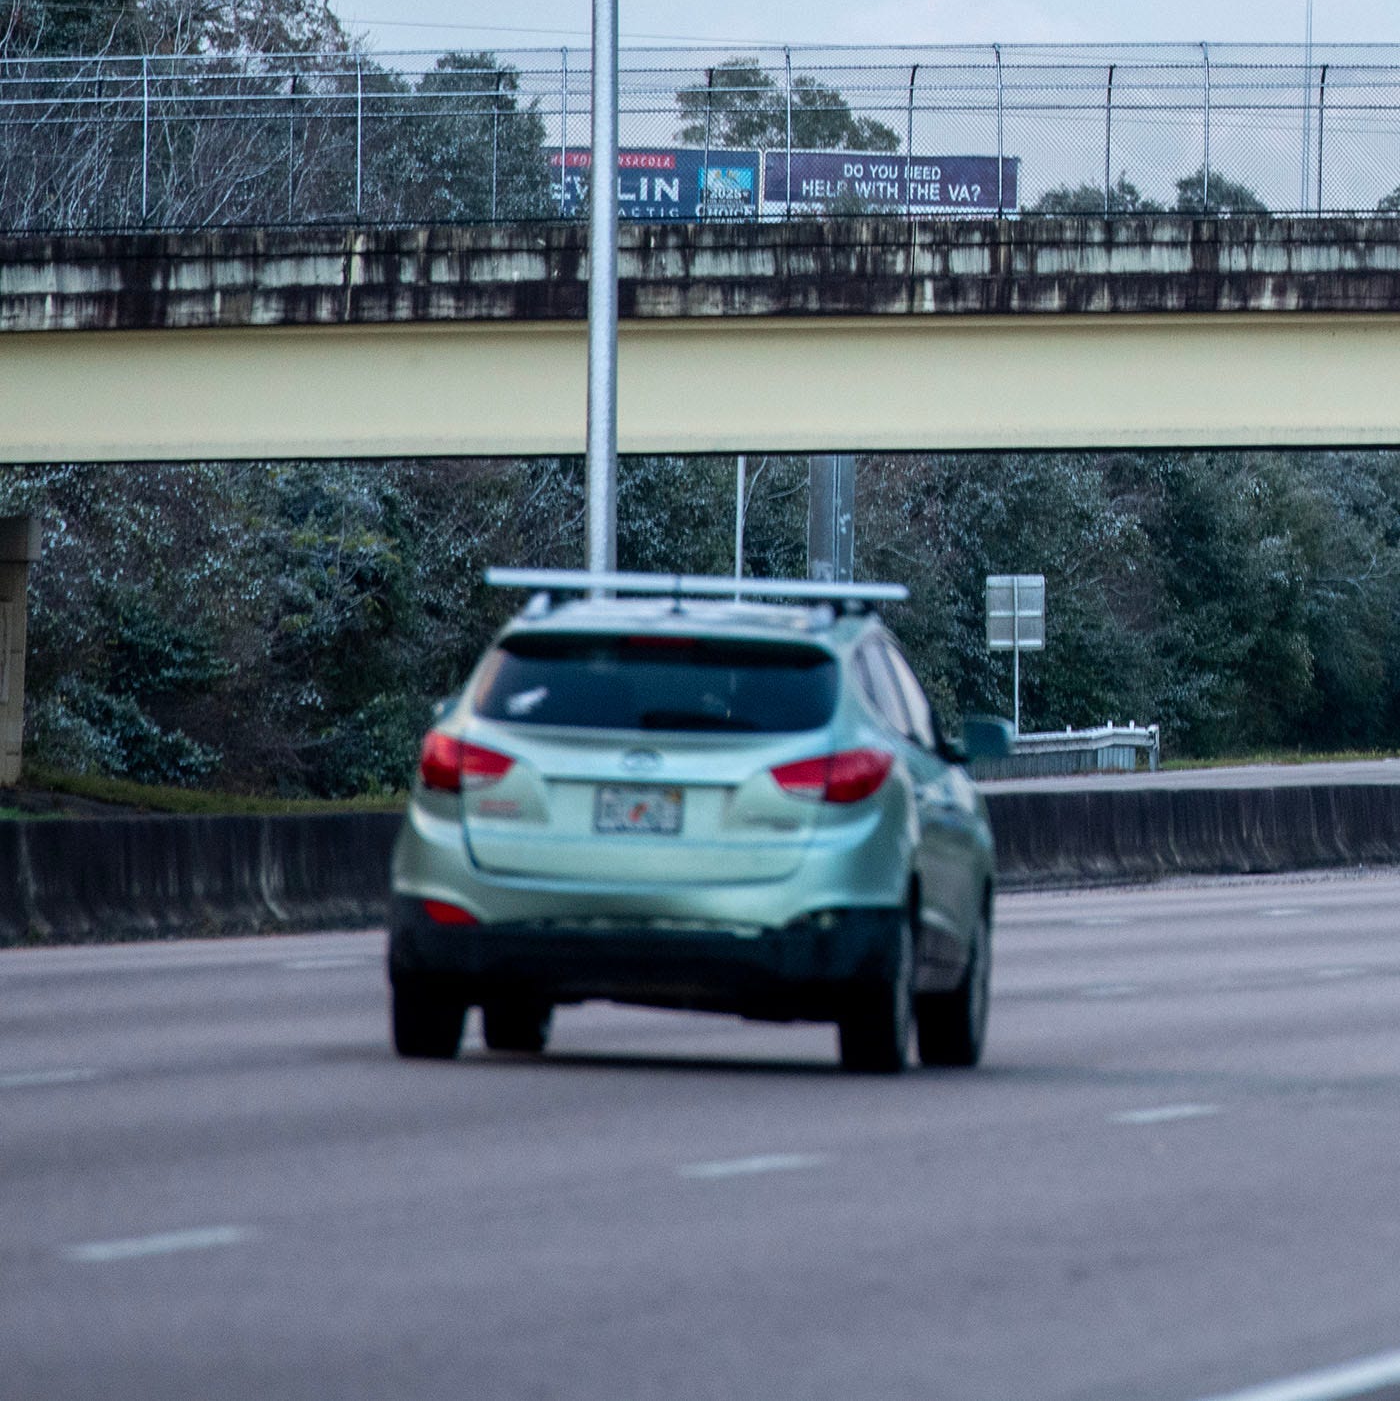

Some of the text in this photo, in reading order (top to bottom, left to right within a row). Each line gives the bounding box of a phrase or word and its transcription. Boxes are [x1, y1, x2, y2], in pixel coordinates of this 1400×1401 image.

[844, 163, 864, 179] DO
[869, 164, 898, 180] YOU
[855, 180, 899, 200] WITH
[909, 182, 941, 202] THE
[948, 184, 982, 202] VA?
